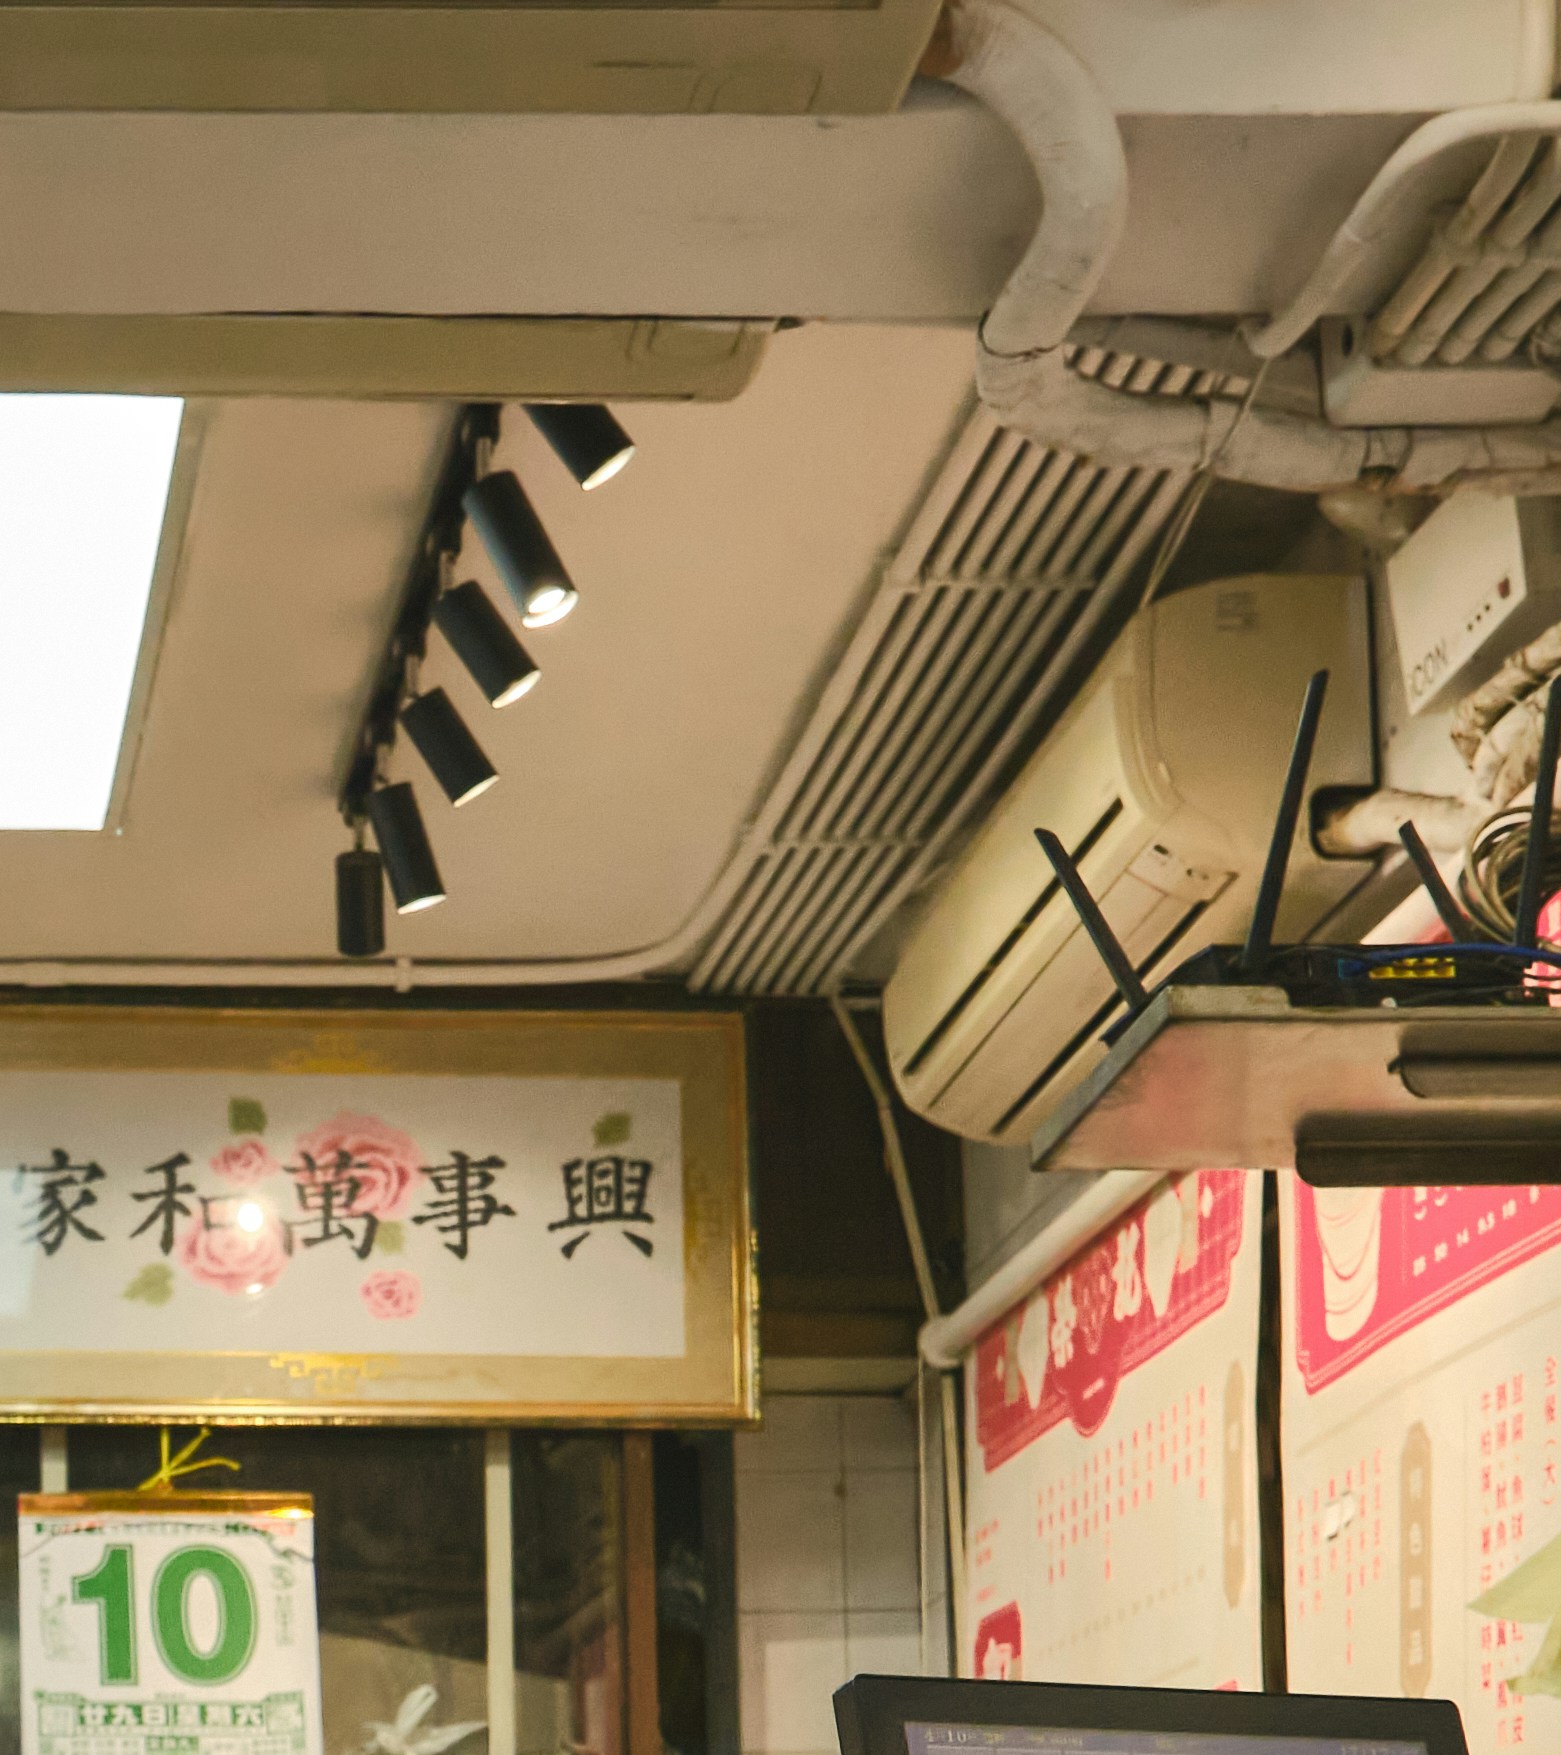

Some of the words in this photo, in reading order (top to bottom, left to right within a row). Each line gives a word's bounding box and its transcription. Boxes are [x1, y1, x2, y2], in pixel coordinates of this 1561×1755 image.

[16, 1147, 657, 1261] 家和萬事興
[71, 1543, 260, 1688] 10
